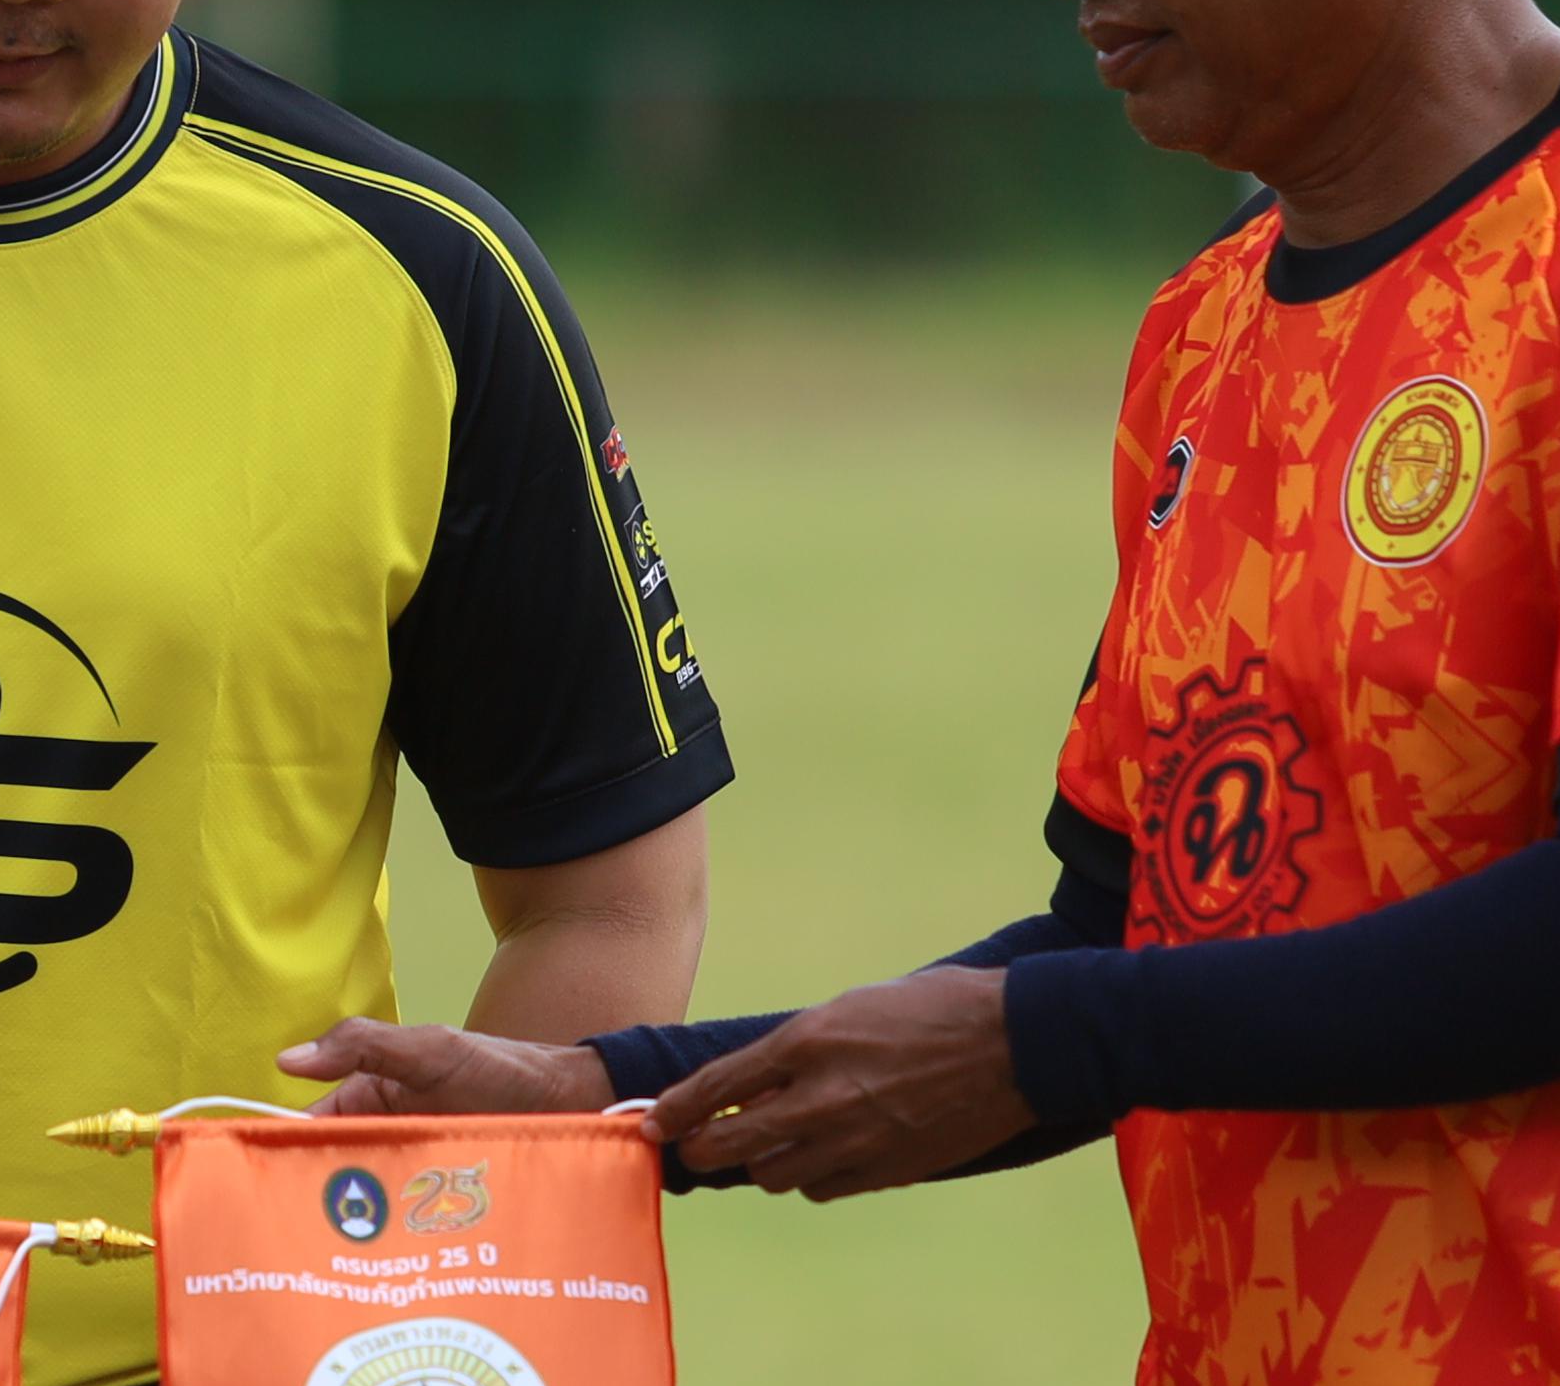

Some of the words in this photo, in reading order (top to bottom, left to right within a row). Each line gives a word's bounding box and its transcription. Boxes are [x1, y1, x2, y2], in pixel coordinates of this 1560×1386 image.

[331, 1254, 430, 1278] ครบรอบ
[437, 1245, 471, 1269] 25
[476, 1241, 499, 1267] ปี
[562, 1278, 649, 1305] แม่สอด
